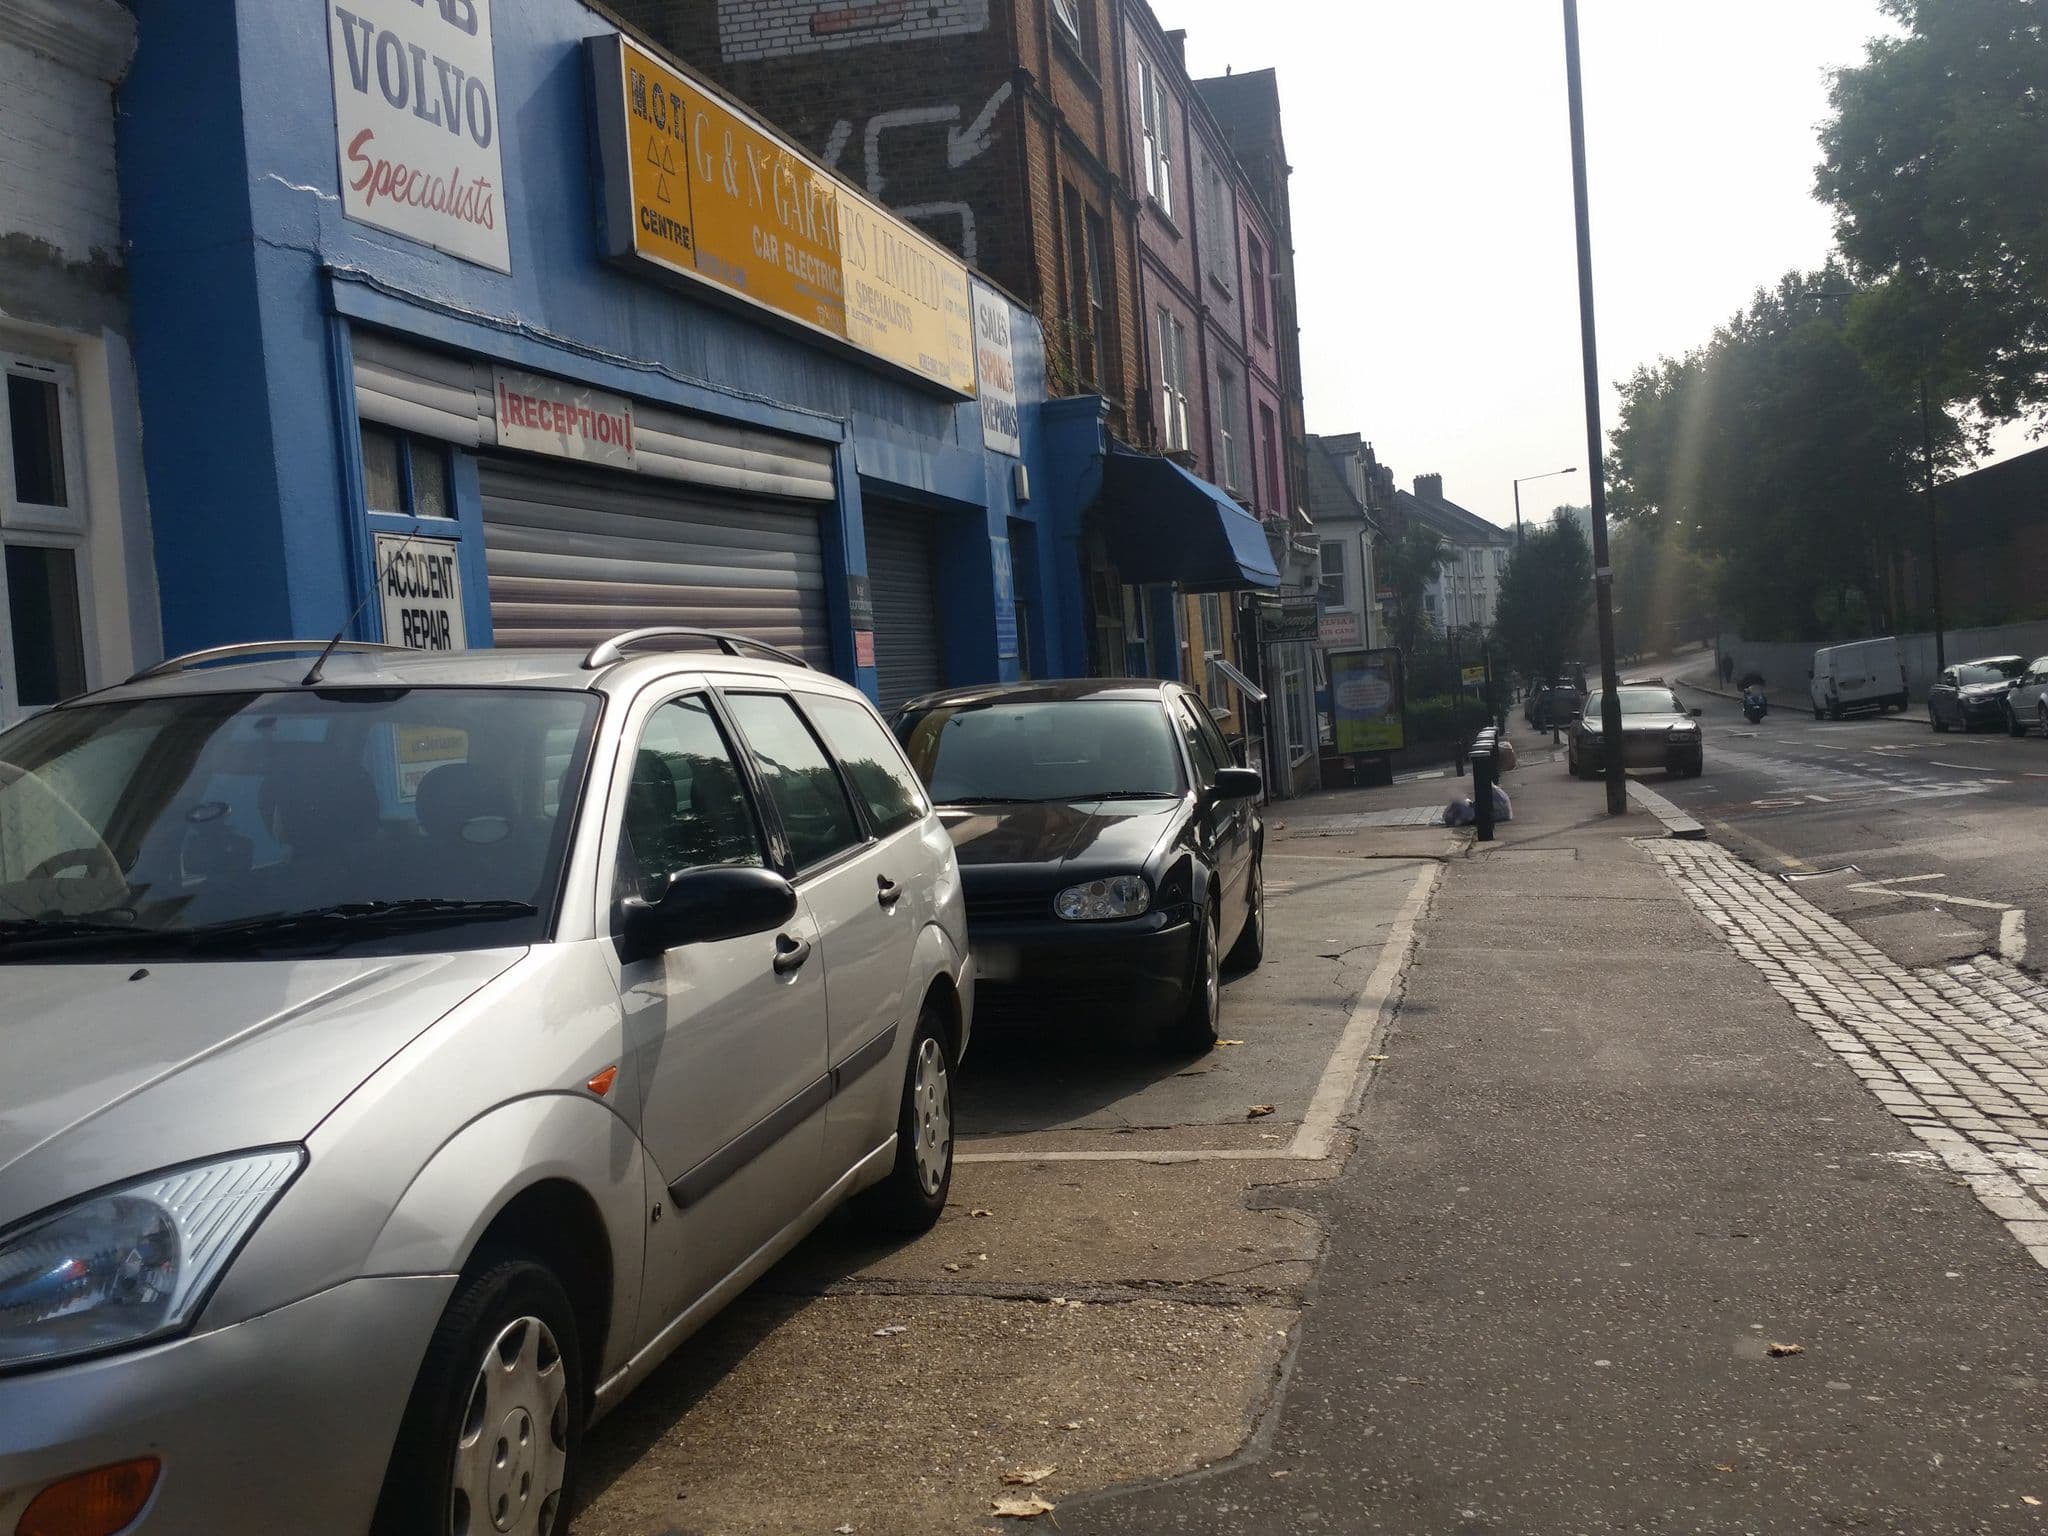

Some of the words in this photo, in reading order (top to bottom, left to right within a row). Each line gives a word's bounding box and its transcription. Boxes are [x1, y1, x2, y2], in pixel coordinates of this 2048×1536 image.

[336, 8, 492, 149] VOLVO
[348, 127, 494, 230] Specialists
[723, 128, 739, 200] &
[746, 142, 764, 211] N
[641, 206, 692, 251] CENTRE
[752, 225, 780, 267] CAR
[855, 279, 913, 334] SPECIALISTS
[979, 303, 1009, 349] SALES
[508, 391, 624, 447] RECEPTION
[982, 395, 1018, 440] REPAIRS
[387, 551, 454, 600] ACCIDENT
[401, 608, 451, 650] REPAIR
